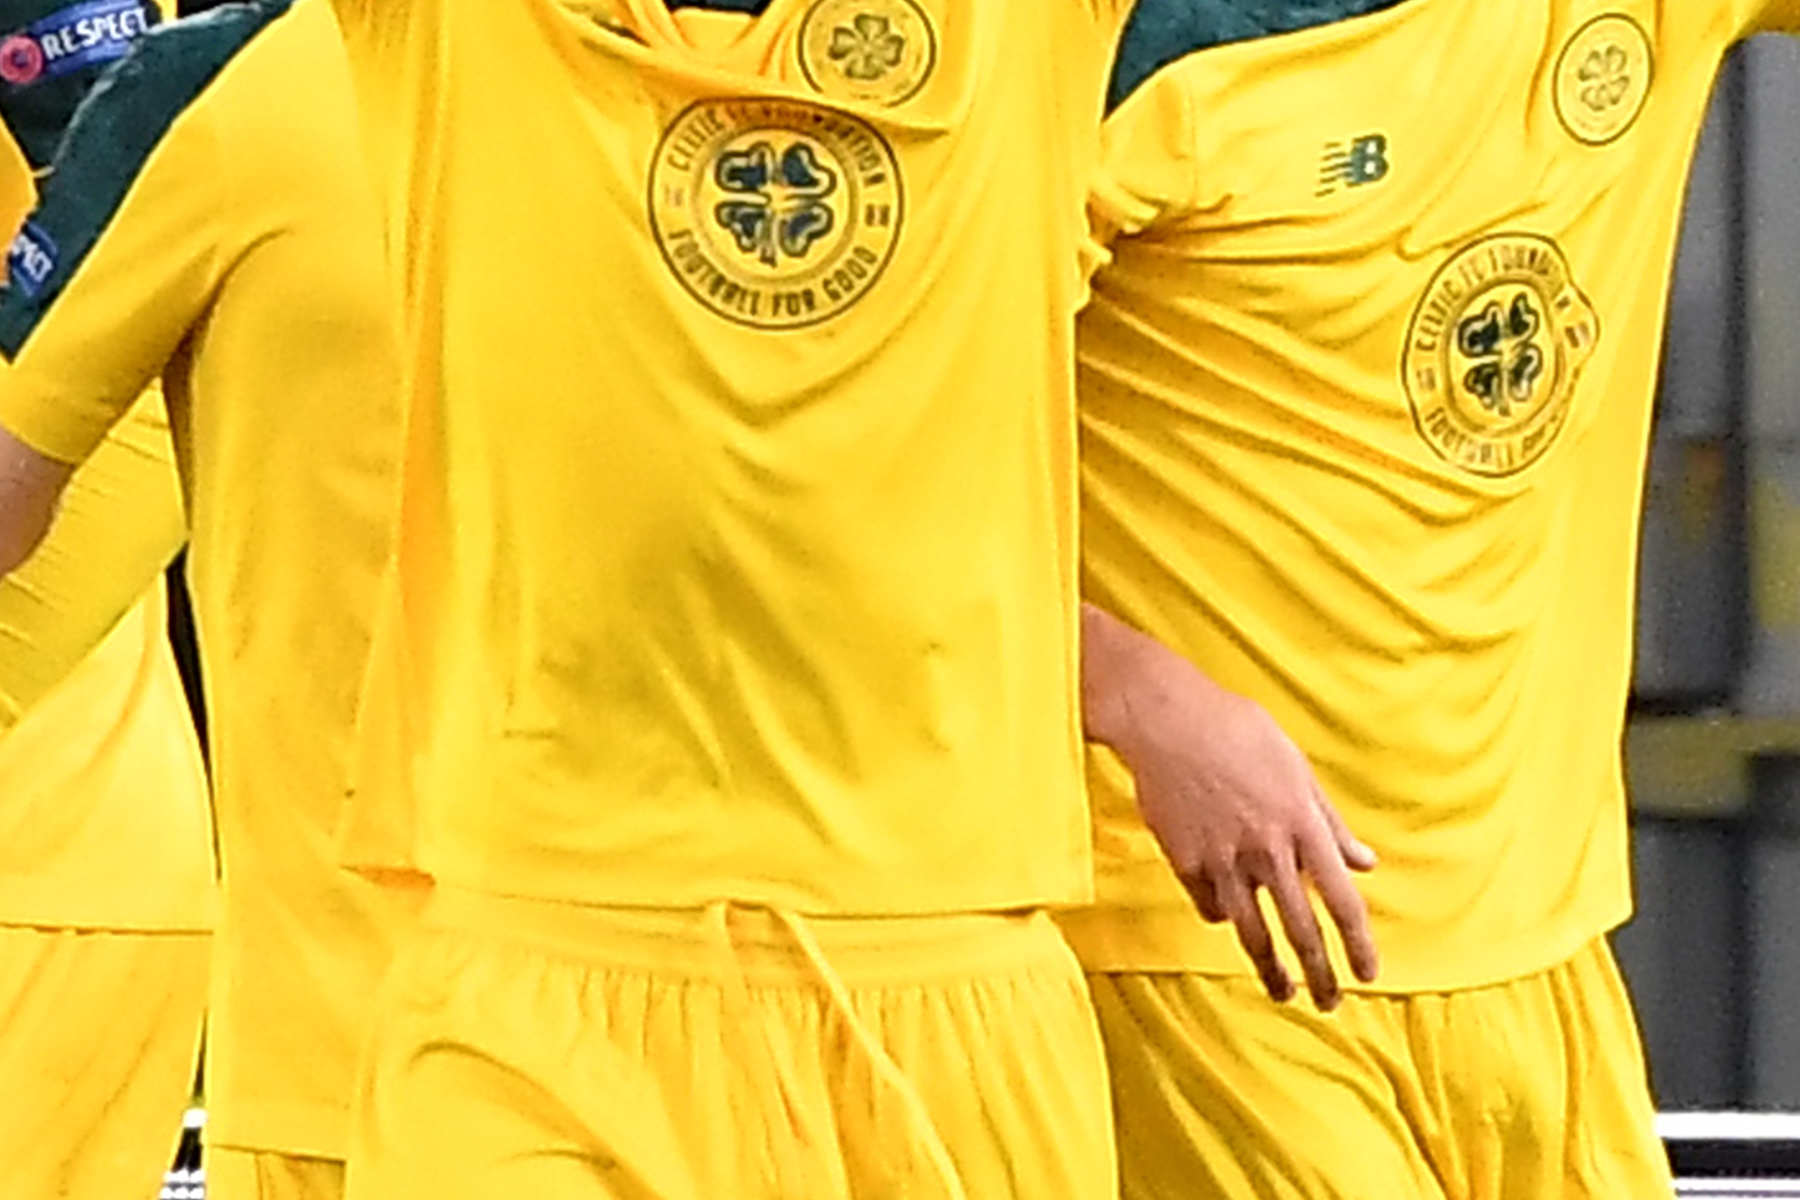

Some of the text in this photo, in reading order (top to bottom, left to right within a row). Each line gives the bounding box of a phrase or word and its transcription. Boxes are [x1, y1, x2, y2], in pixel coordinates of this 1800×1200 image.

[41, 7, 148, 60] RESPECT
[772, 288, 818, 317] FOR
[822, 246, 878, 302] GOOD
